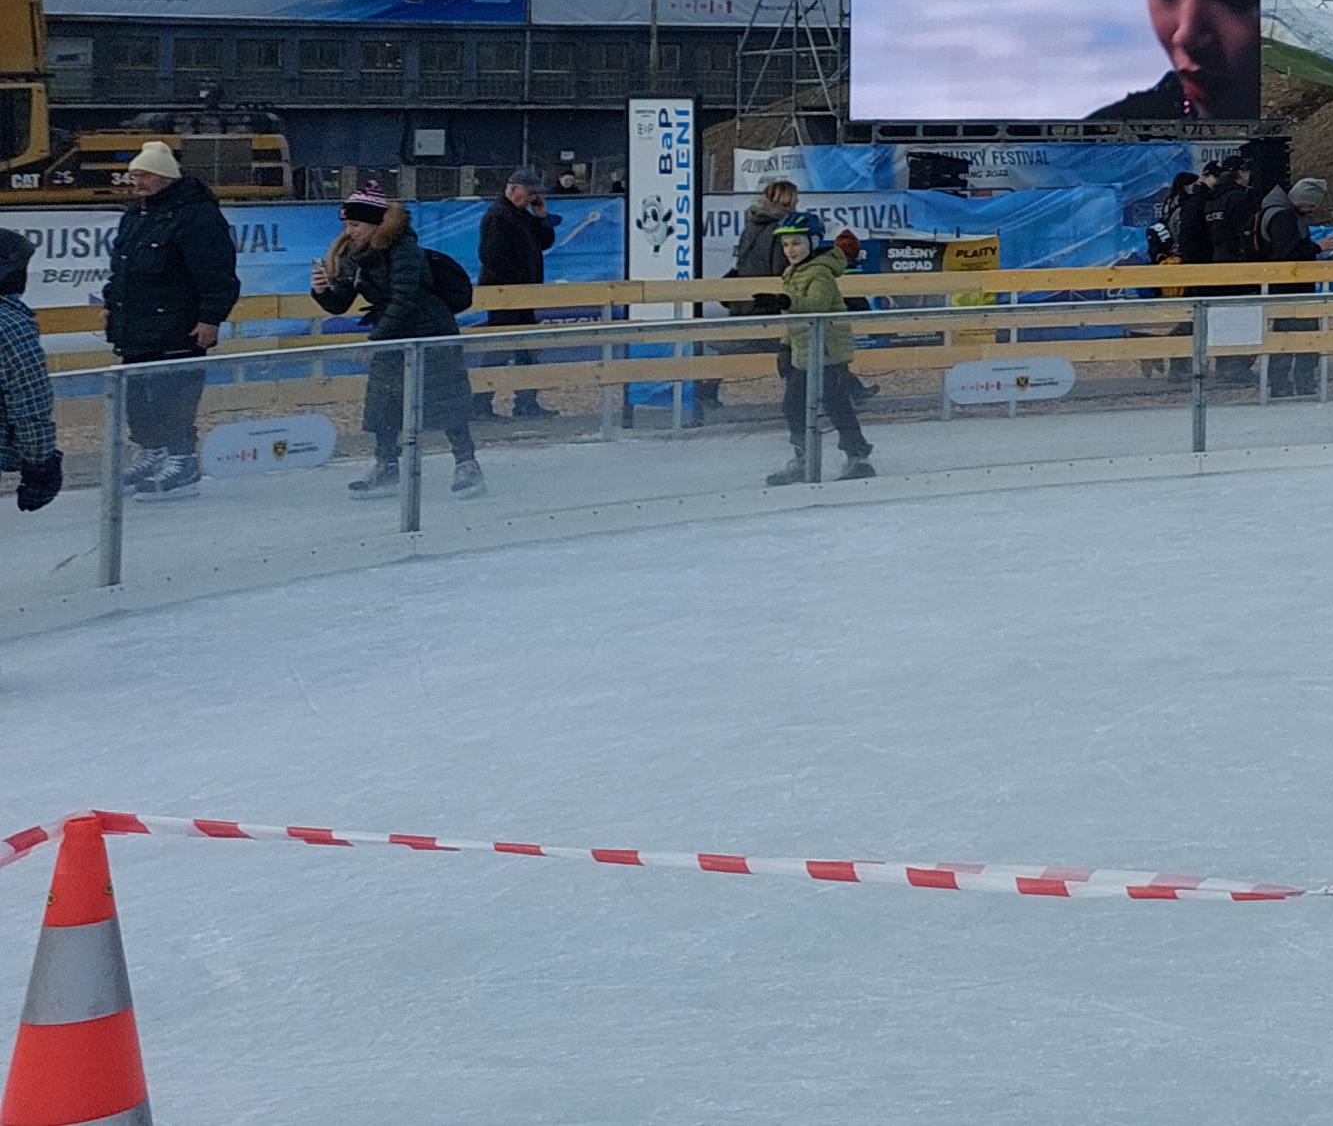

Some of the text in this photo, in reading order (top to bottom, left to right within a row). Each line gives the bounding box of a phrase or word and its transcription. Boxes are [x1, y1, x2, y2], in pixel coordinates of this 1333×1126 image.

[659, 108, 672, 174] BaP
[993, 150, 1051, 165] FESTIVAL
[11, 173, 40, 189] CAT
[956, 245, 998, 259] PLASTY
